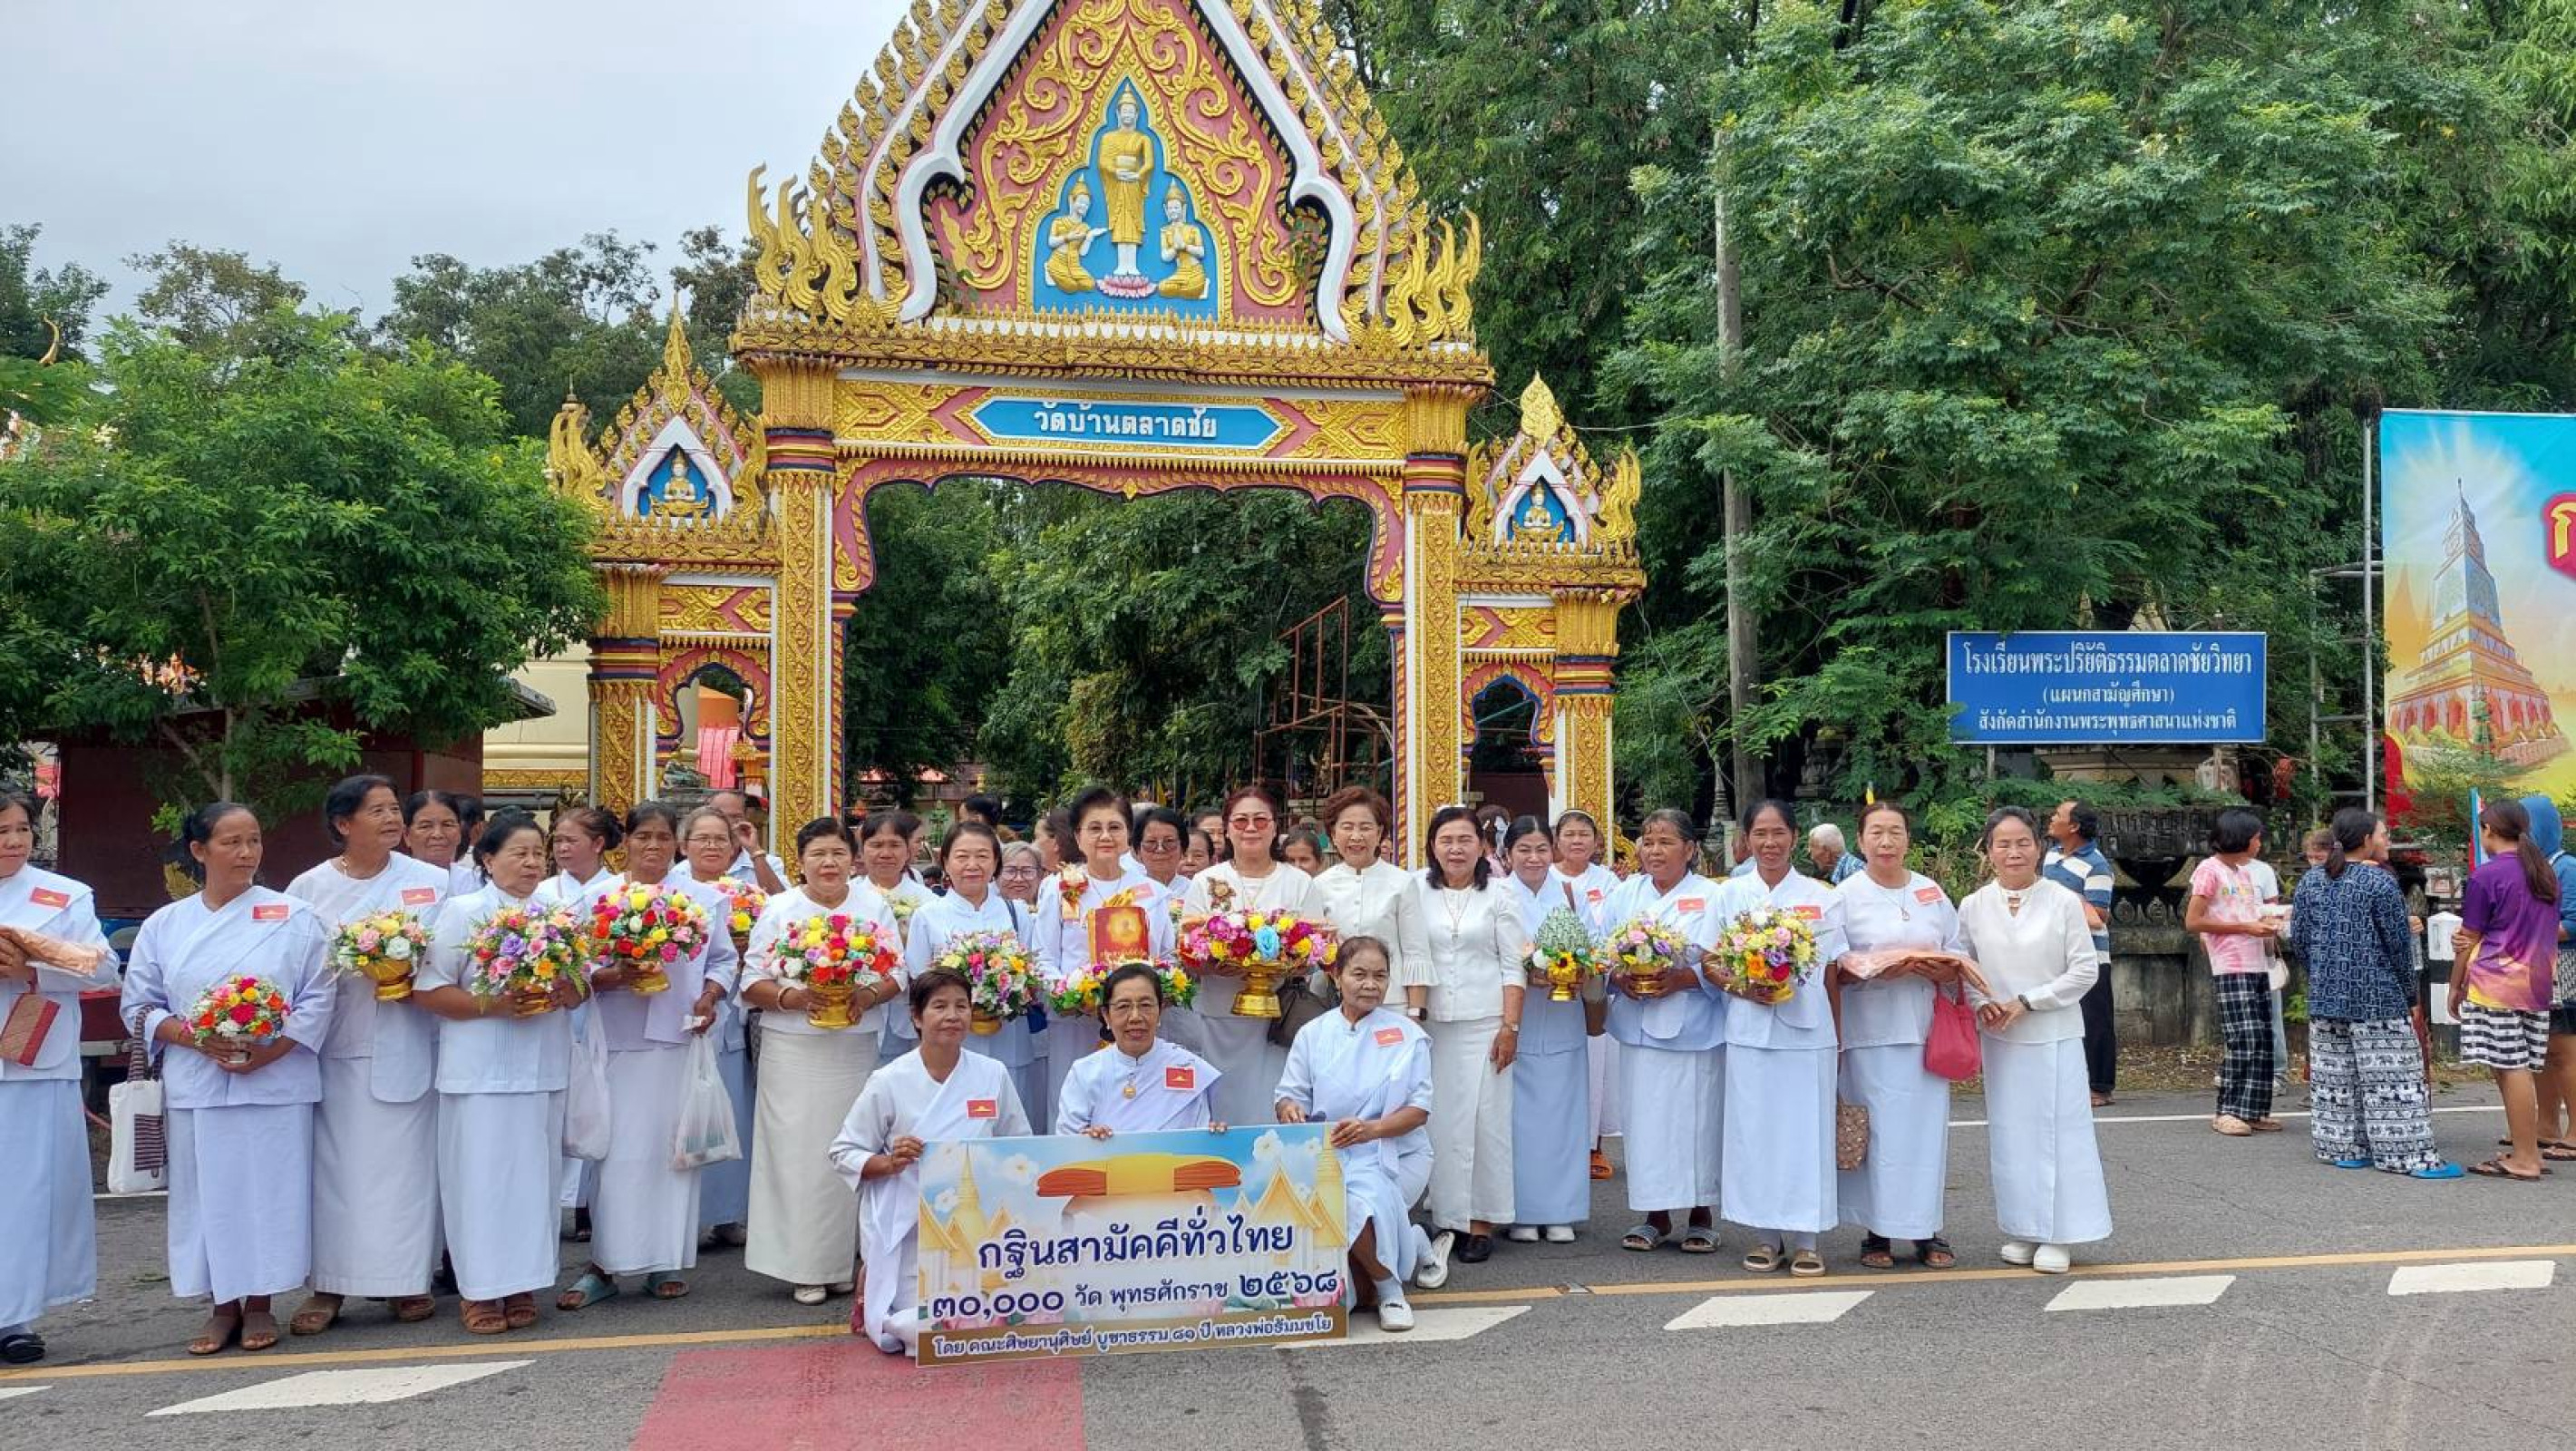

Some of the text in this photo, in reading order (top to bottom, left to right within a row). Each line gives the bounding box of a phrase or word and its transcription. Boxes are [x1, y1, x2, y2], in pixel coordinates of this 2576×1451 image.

[1034, 401, 1217, 437] วัดบ้านตลาดชัย
[1963, 640, 2252, 674] โรงเรียนพระปริยัติธรรมตลาดชัยวิทยา
[2043, 680, 2174, 708] (แผนกสามัญศึกษา)
[1978, 707, 2237, 736] สังกัดสำนักงานพระพุทธศาสนาแห่งชาติ
[978, 1205, 1293, 1280] กฐินสามัคคีทั่วไทย
[933, 1269, 1337, 1320] ๓๐,๐๐๐ วัด พุทธศักราช ๒๕๖๘
[935, 1314, 1332, 1355] โดย คณะศิษยานุศิษย์ บูชาธรรม ๘๑ ปี หลวงพ่อธัมมชโย
